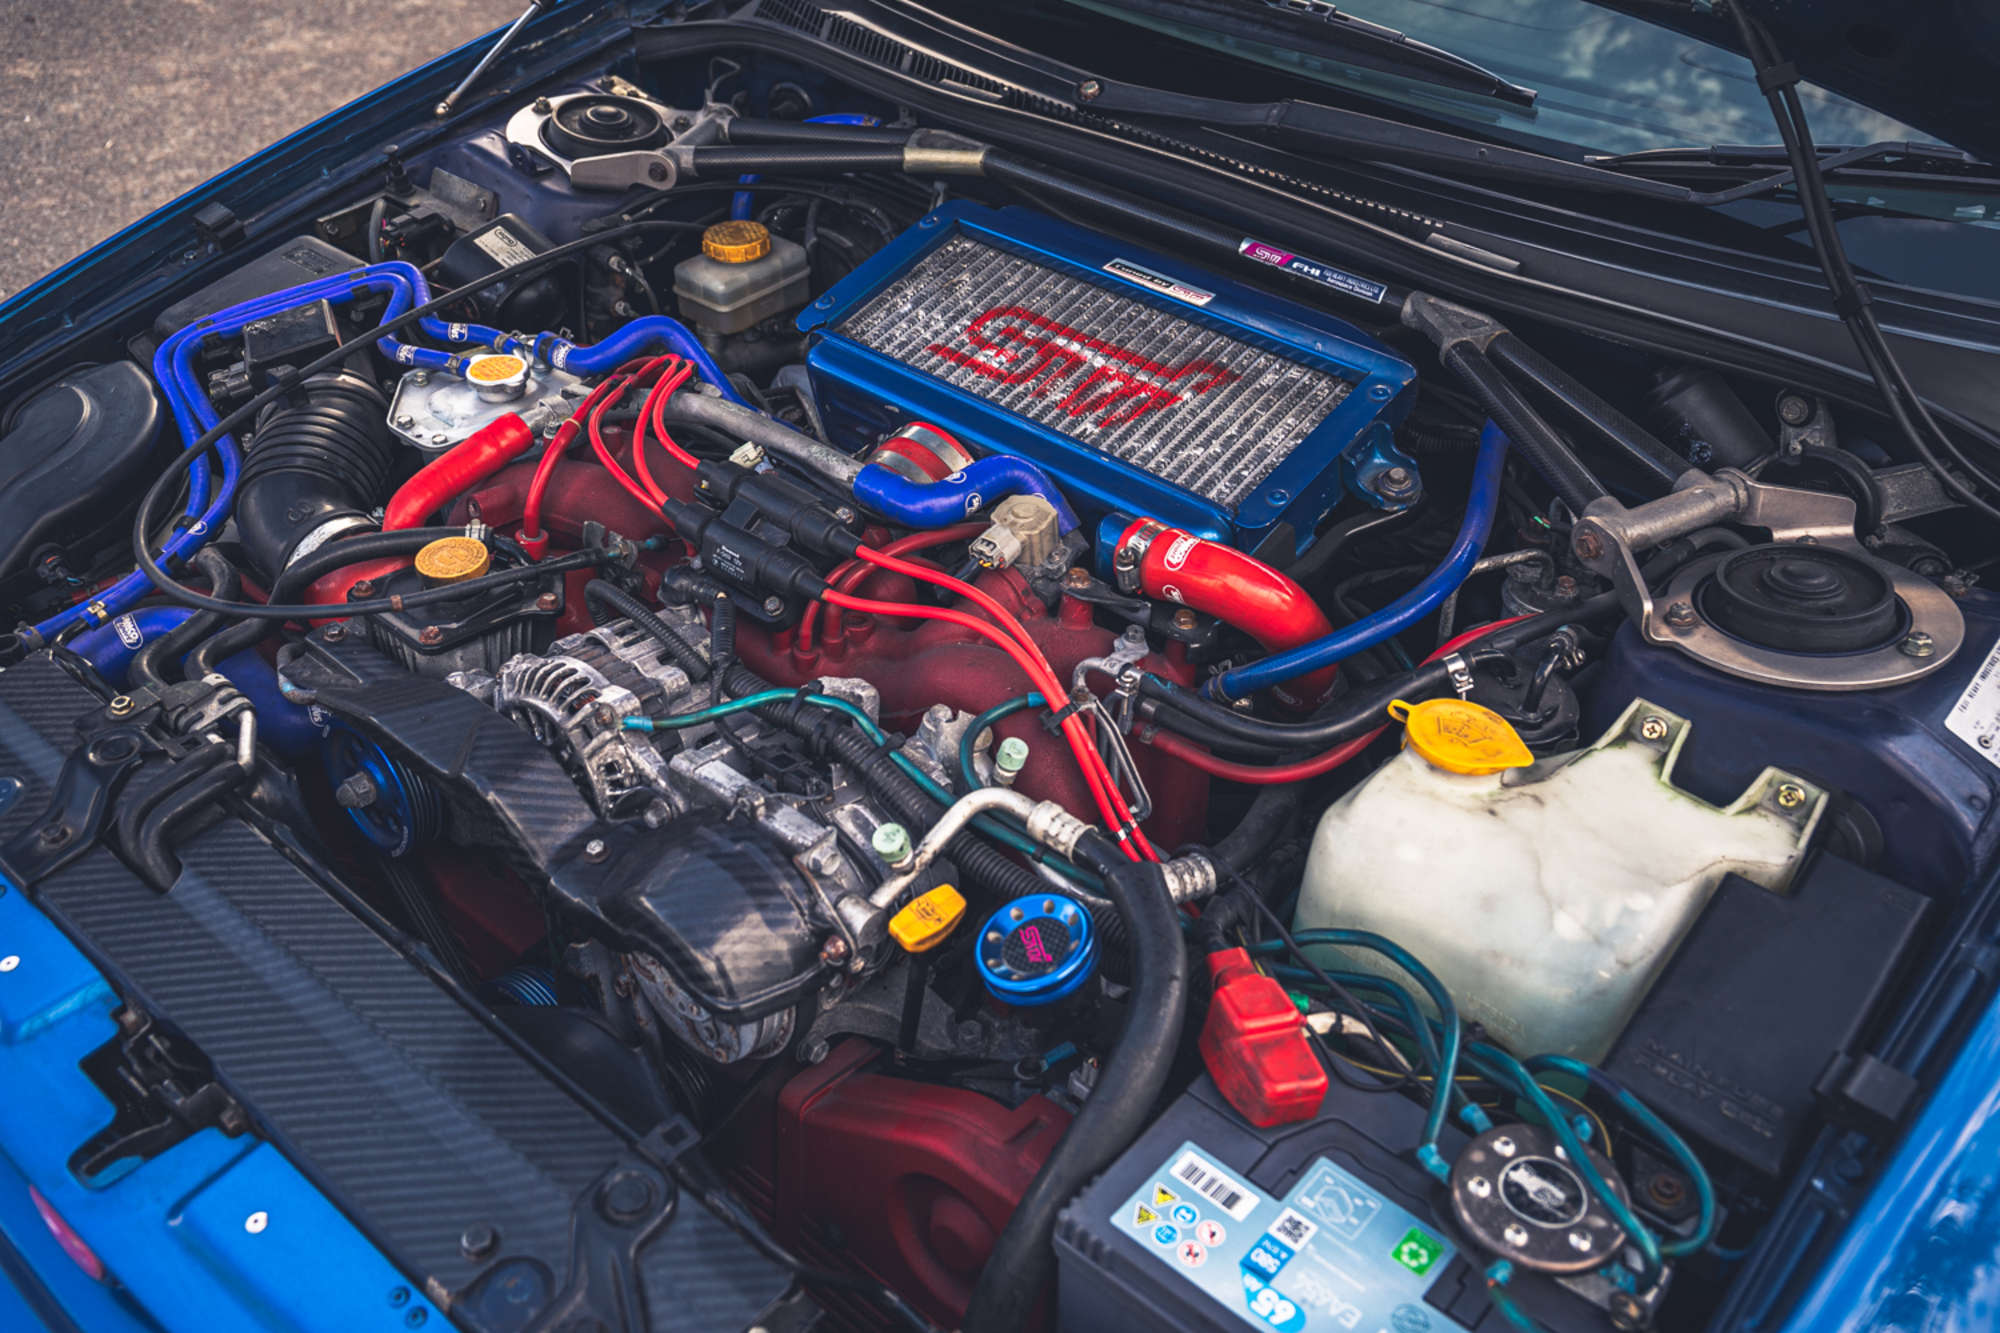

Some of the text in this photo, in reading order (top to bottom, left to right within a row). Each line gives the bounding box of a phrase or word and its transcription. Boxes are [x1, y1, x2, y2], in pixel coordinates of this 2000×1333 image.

[1291, 261, 1321, 277] FHI
[1018, 925, 1053, 963] STI
[1250, 1287, 1297, 1326] 65
